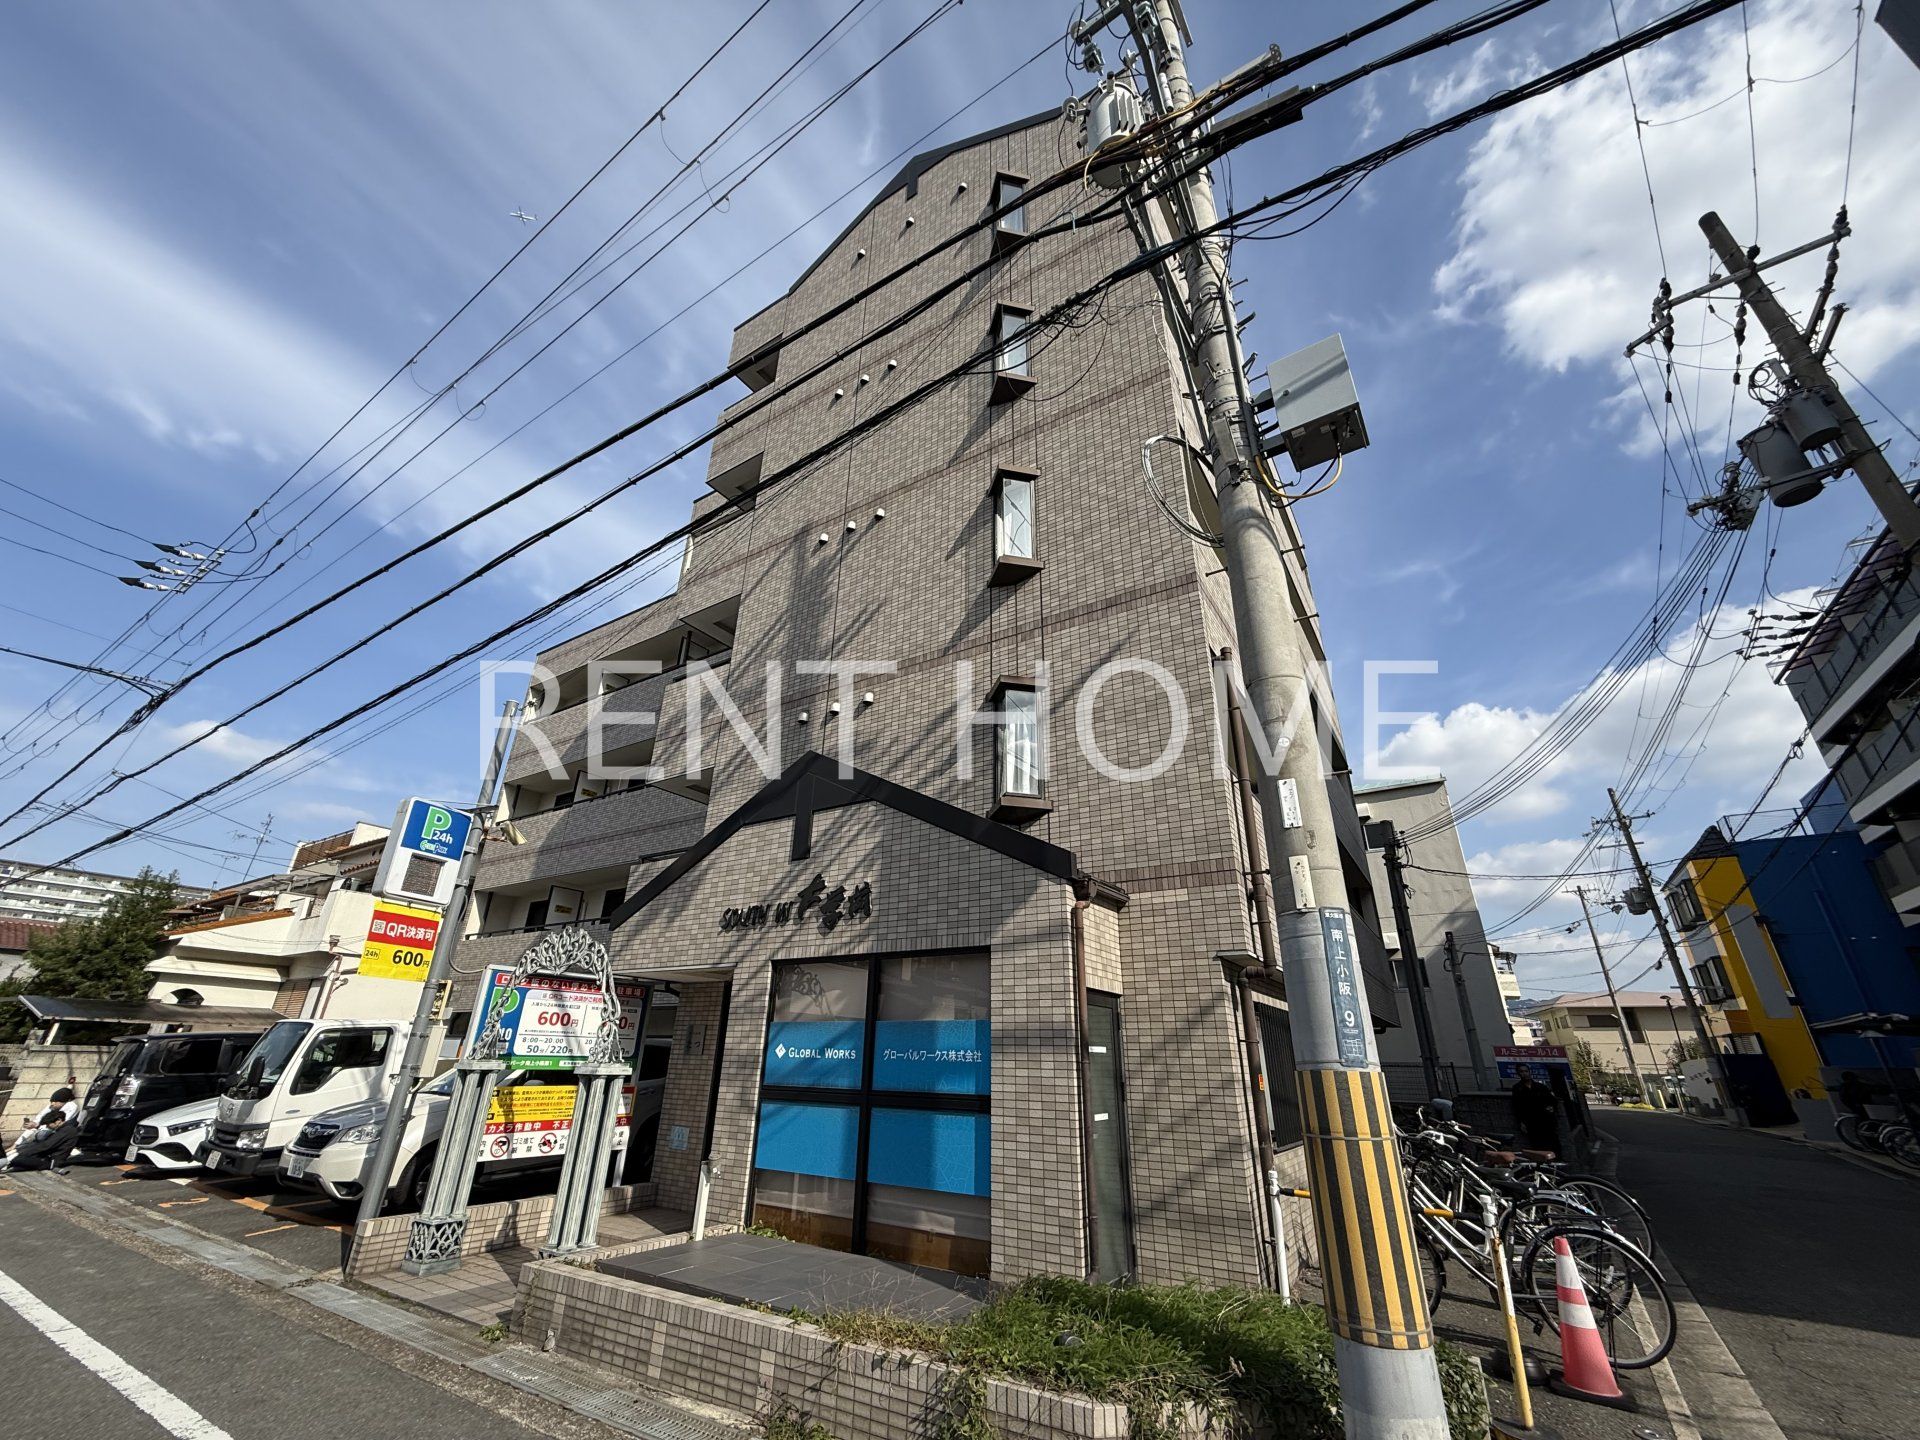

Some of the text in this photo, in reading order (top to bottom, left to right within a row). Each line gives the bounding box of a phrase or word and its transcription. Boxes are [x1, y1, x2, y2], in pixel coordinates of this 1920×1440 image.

[421, 806, 452, 840] P
[432, 830, 453, 844] 24h
[386, 922, 435, 942] QR決済可
[365, 950, 379, 958] 24h
[1331, 929, 1352, 996] 南上小阪
[1344, 1010, 1355, 1027] 9
[788, 1047, 856, 1060] GLOBAL WORKS
[883, 1049, 982, 1063] グローバルワークス株式会社
